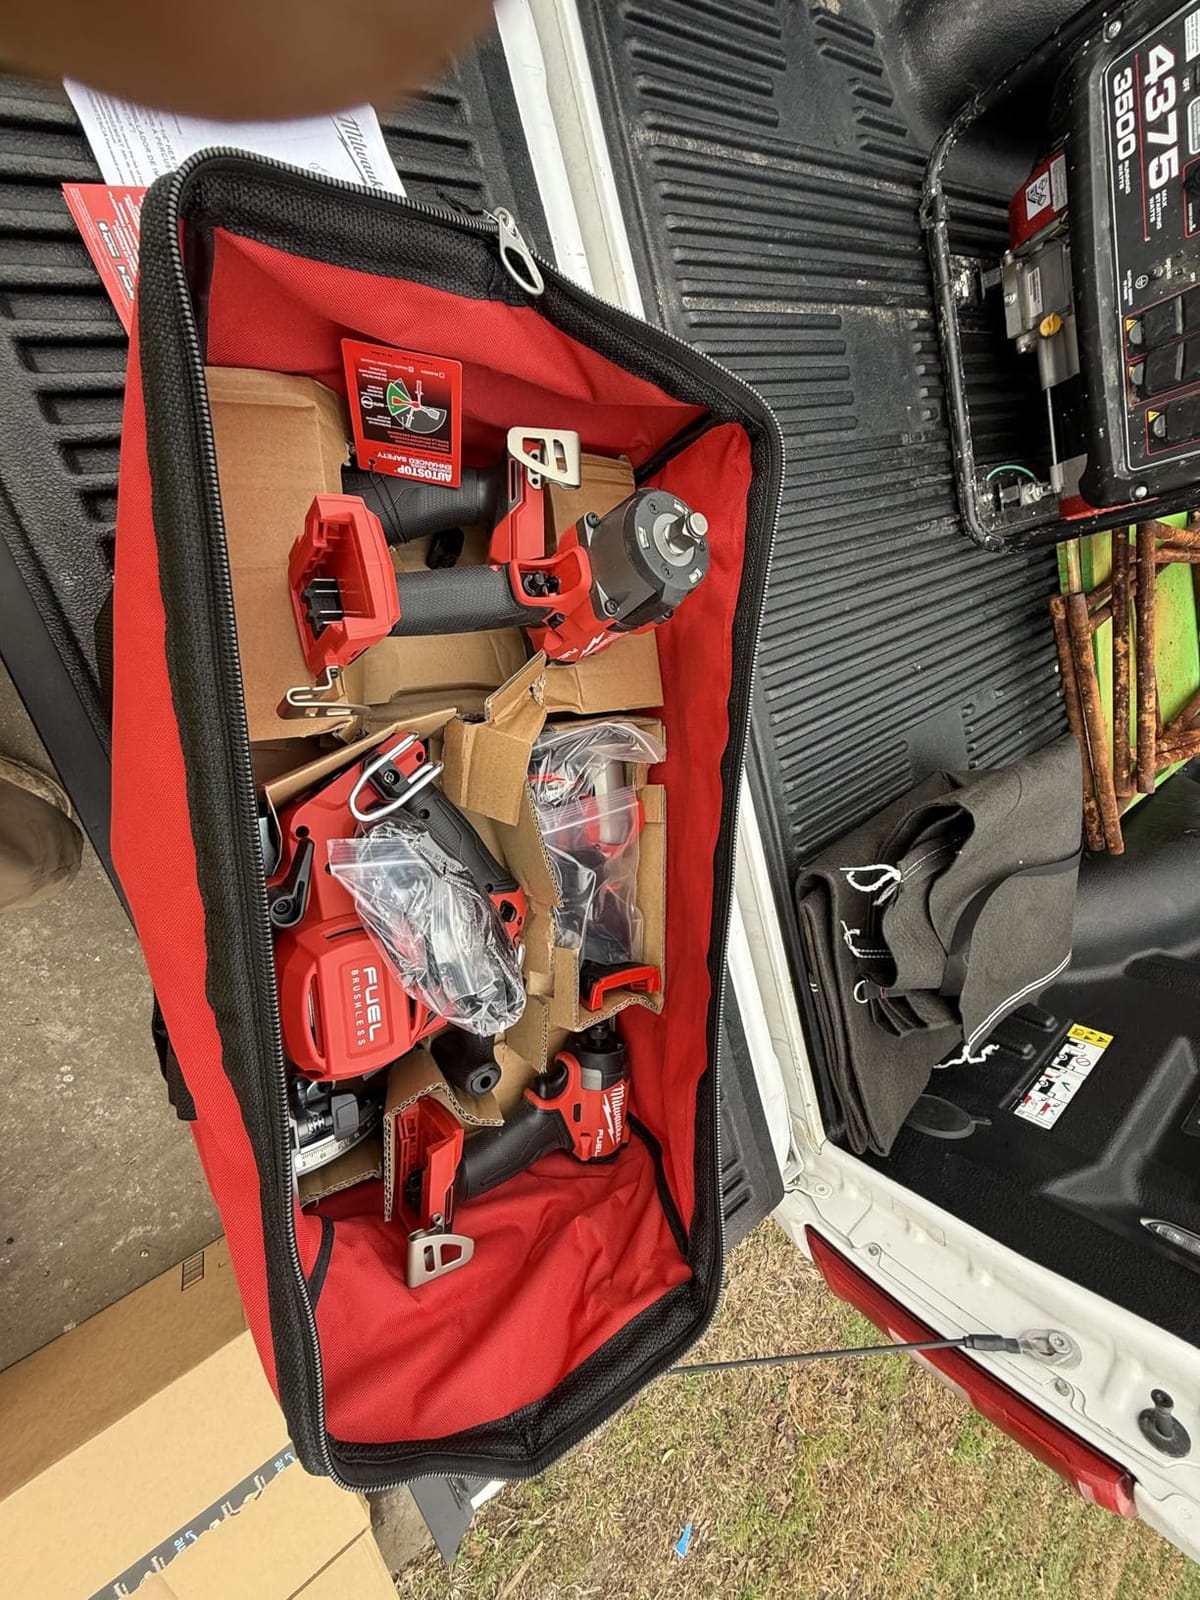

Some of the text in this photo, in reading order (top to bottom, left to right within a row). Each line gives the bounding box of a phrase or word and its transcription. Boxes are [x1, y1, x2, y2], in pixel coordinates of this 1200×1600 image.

[1113, 67, 1136, 161] 3500
[1144, 44, 1179, 190] 4375
[377, 451, 407, 463] SAFETY
[398, 464, 453, 482] AUTOSTOP
[409, 458, 452, 470] ENHANCED
[351, 969, 366, 1047] BRUSHLESS
[363, 966, 382, 1042] FUEL
[594, 1128, 604, 1157] FUEL
[610, 1084, 625, 1145] Milwaukee
